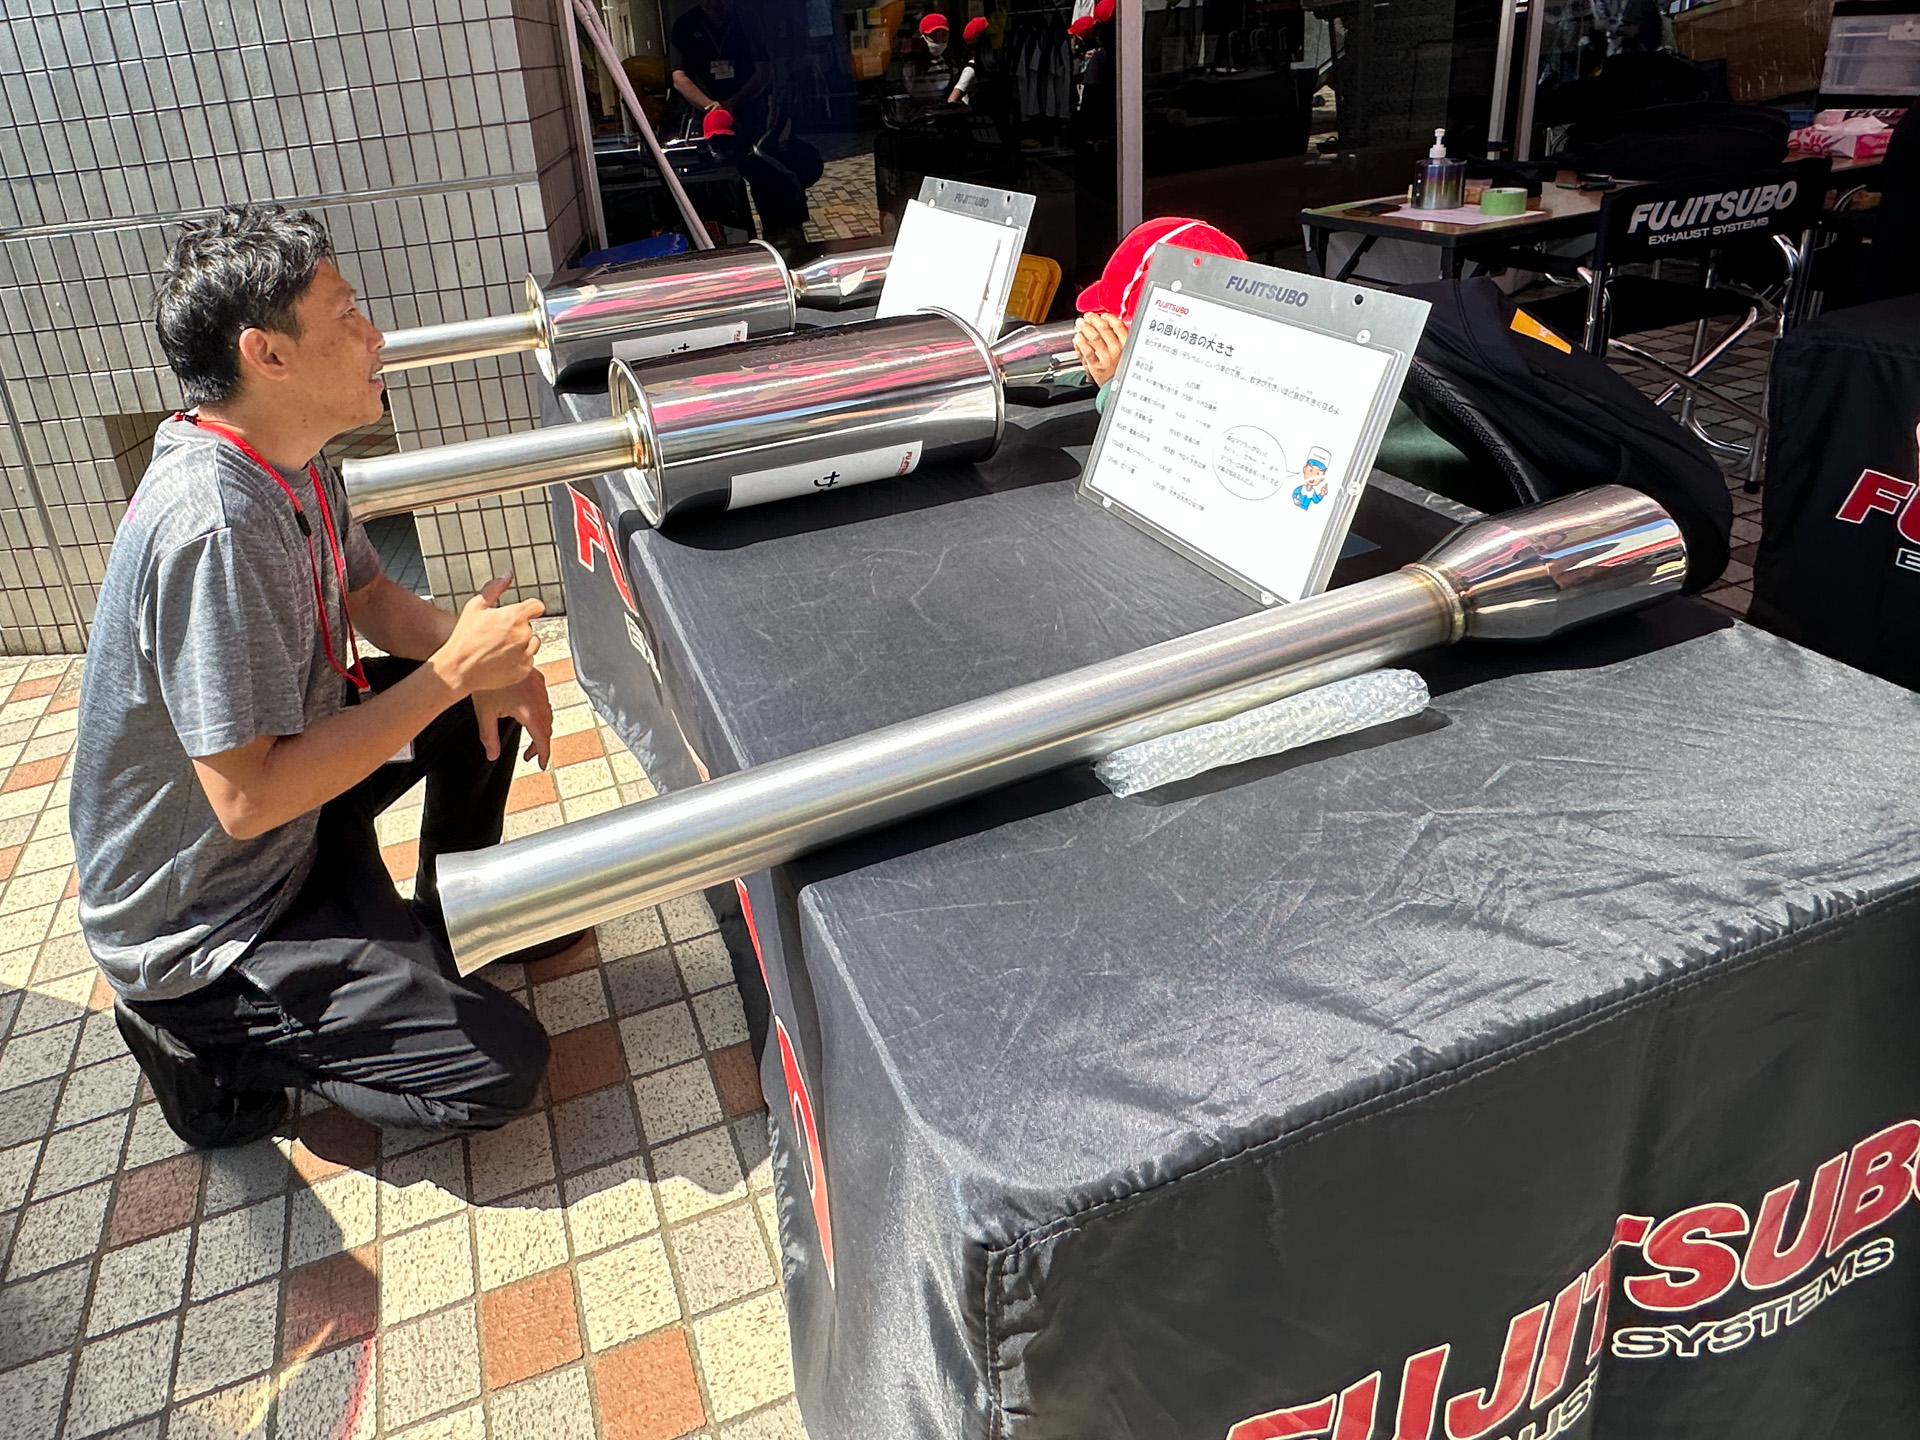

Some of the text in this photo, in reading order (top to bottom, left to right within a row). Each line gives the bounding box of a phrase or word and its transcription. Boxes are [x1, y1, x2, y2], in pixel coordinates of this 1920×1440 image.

[1627, 180, 1797, 234] FUJITSUBO
[1648, 216, 1769, 245] EXHAUST SYSTEMS
[1155, 299, 1190, 315] FUJITSUBO
[1225, 275, 1309, 308] FUJITSUBO
[1149, 319, 1235, 357] 身の回りの音の大きさ
[1611, 1237, 1894, 1358] SYSTEMS
